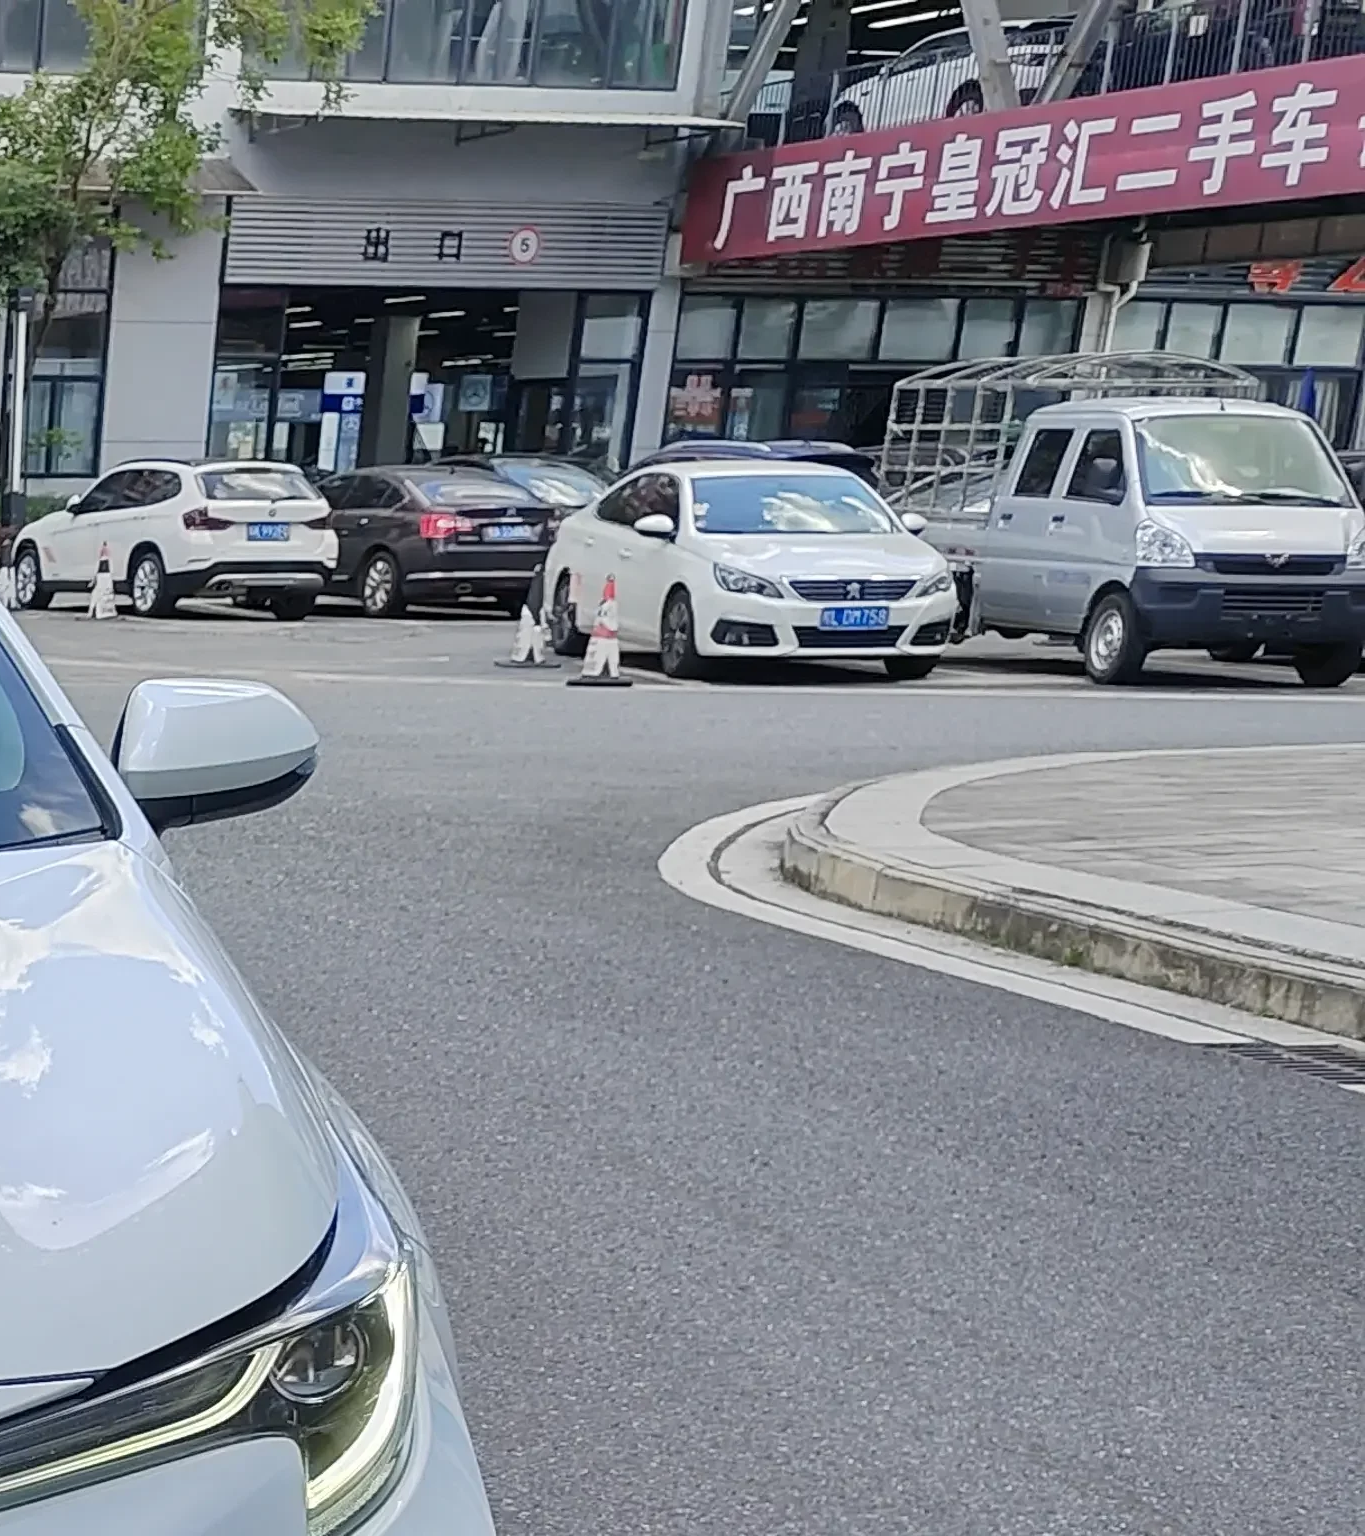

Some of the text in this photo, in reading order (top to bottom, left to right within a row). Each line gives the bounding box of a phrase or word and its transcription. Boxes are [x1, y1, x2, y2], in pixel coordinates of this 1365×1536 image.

[713, 83, 1365, 250] 广西南宁皇冠汇二手车
[361, 227, 463, 262] 出口
